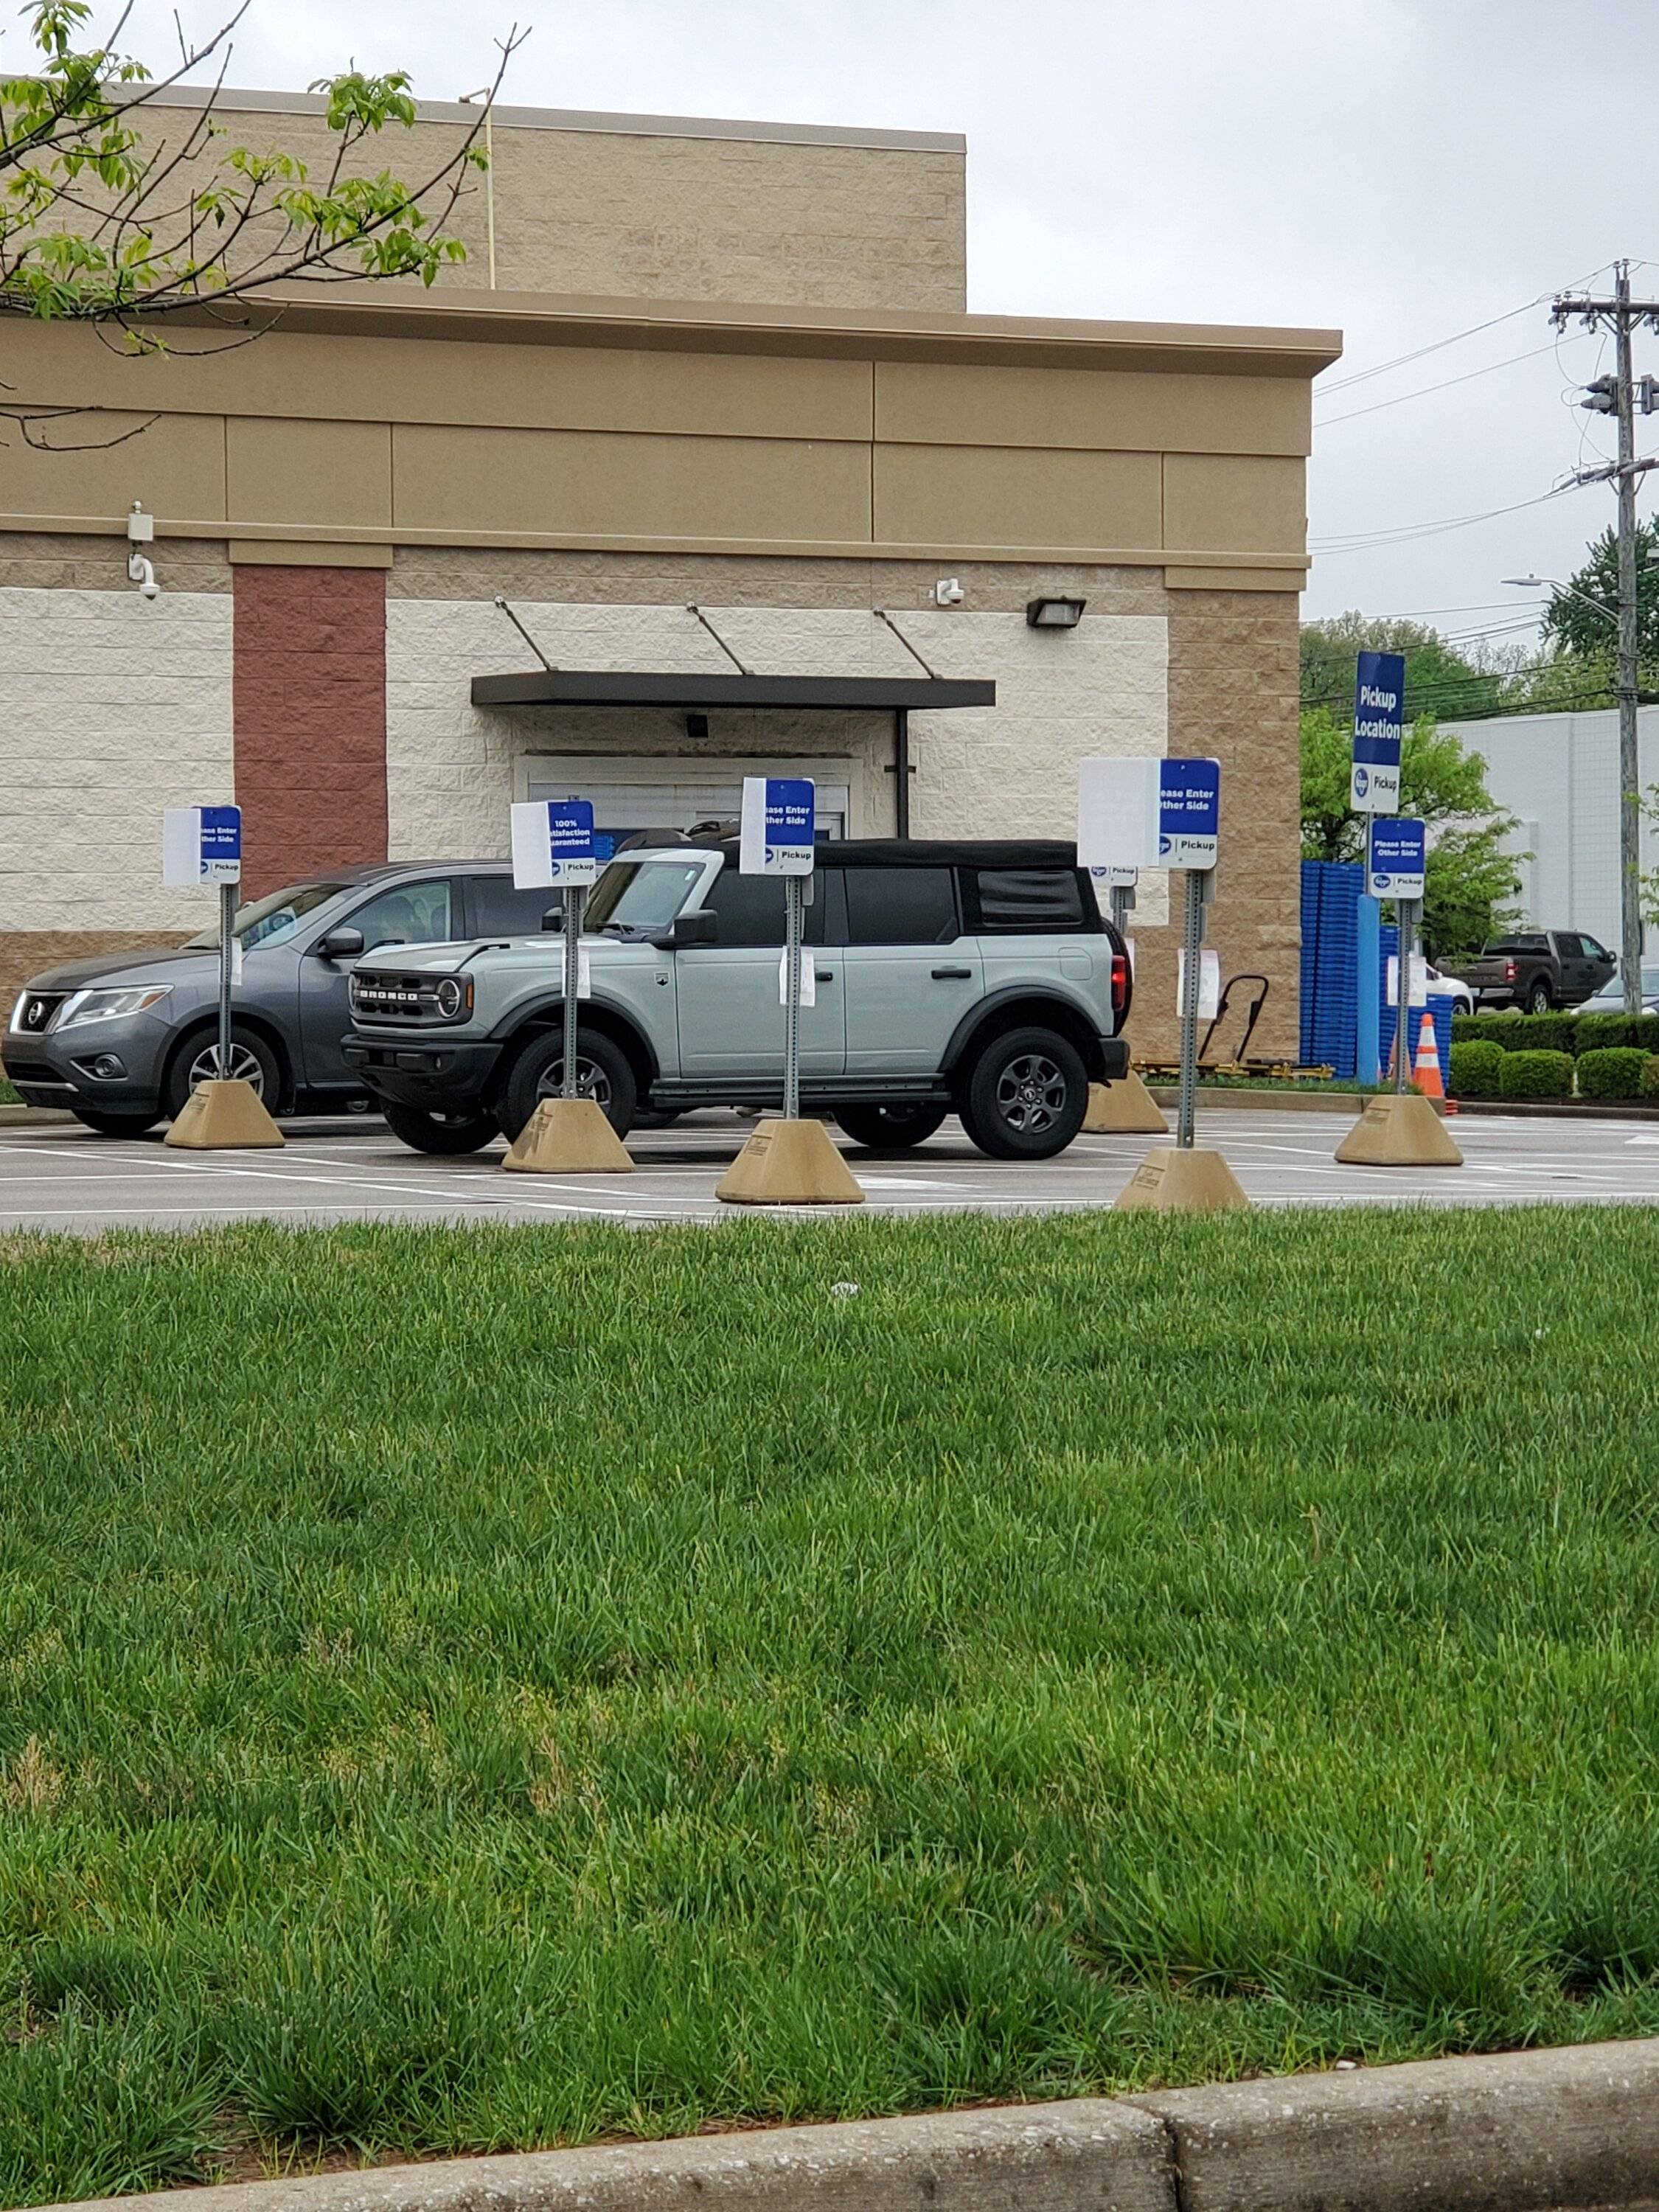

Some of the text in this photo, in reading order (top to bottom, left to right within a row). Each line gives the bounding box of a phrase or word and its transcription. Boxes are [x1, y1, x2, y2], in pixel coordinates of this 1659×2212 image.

[1360, 686, 1397, 712] Pickup
[1354, 715, 1401, 740] Location
[1374, 776, 1397, 793] Pickup
[1161, 789, 1214, 799] ease Enter
[1186, 801, 1209, 810] Side
[785, 806, 810, 815] Enter
[554, 819, 577, 827] 100%
[766, 816, 806, 825] ther Side
[550, 828, 590, 837] tisfaction
[1181, 841, 1214, 851] Pickup
[782, 851, 811, 860] Pickup
[215, 863, 239, 872] Pickup
[568, 863, 594, 872] Pickup
[360, 990, 418, 1001] BRONCO
